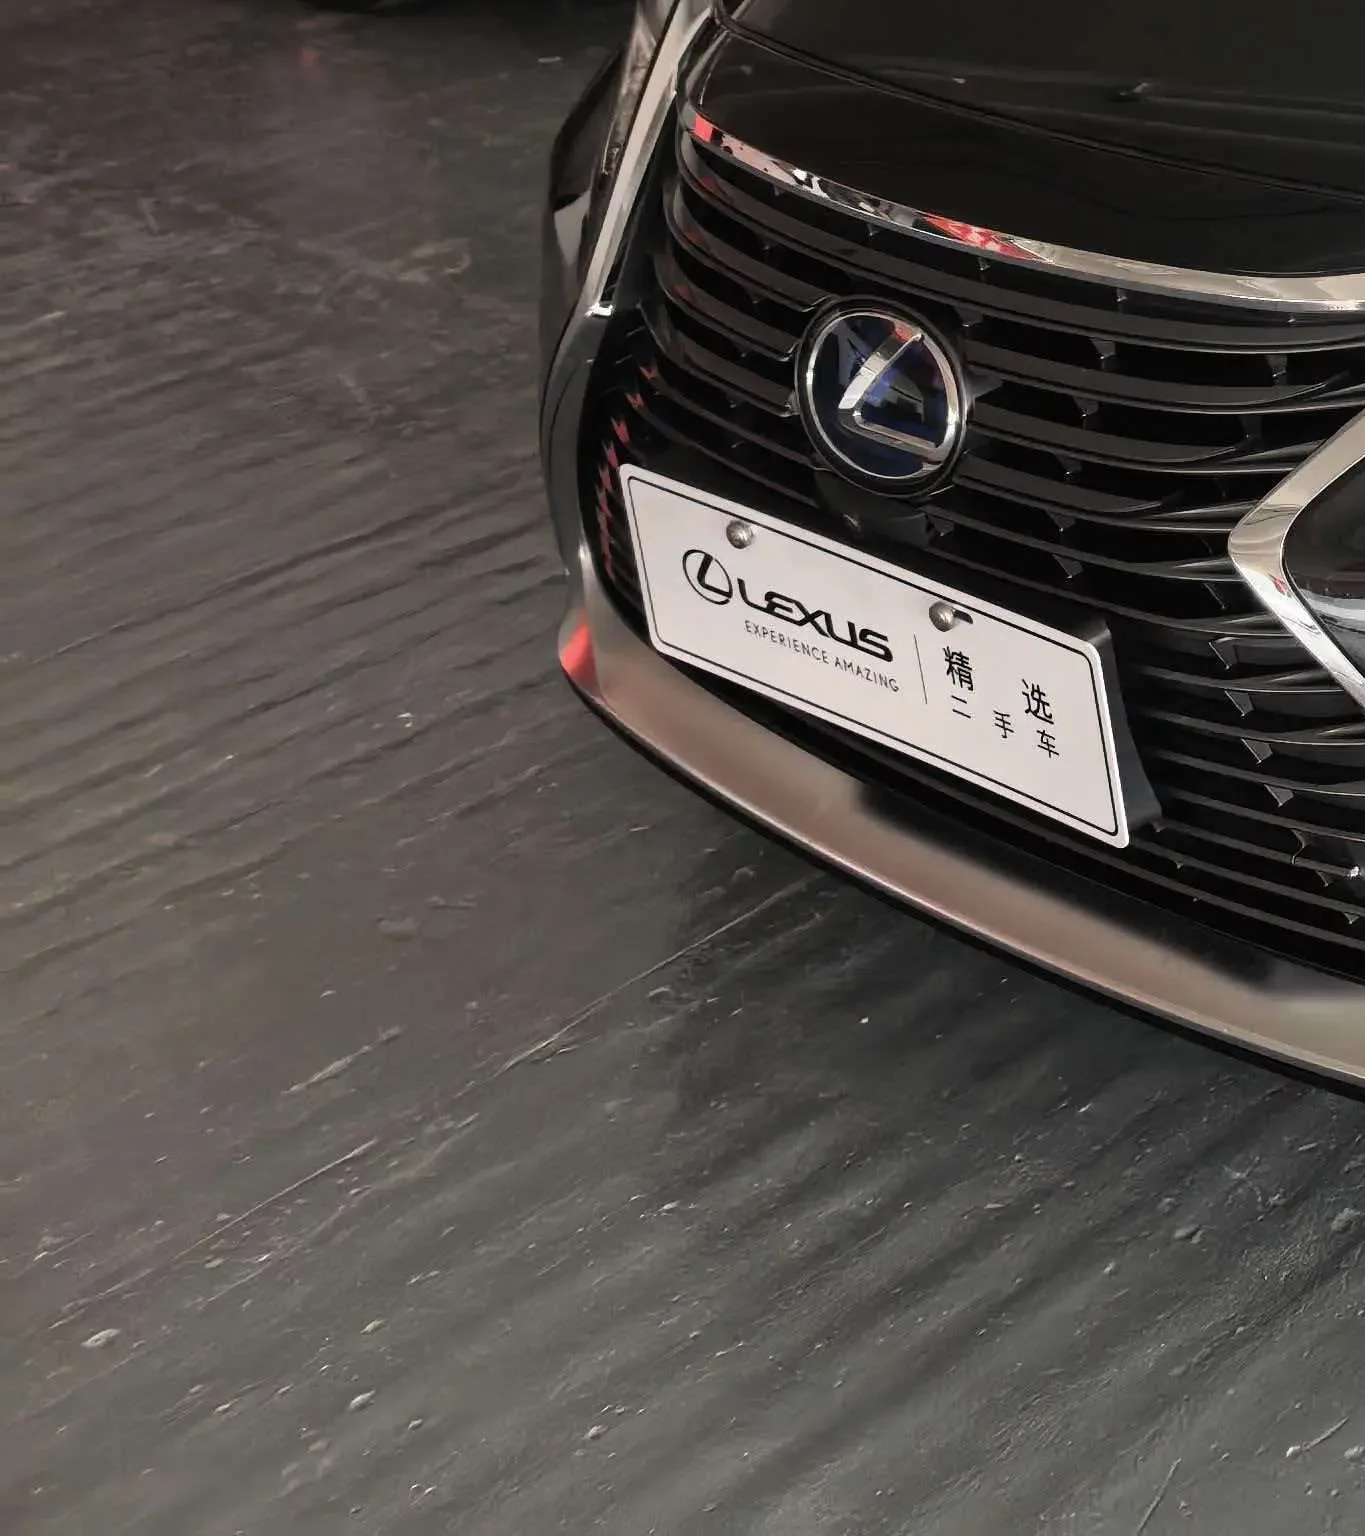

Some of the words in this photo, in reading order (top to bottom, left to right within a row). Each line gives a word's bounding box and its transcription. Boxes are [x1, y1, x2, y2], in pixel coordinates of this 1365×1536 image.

[737, 578, 893, 663] LEXUS
[744, 619, 829, 665] EXPERIENCE
[834, 657, 899, 702] AMAZING
